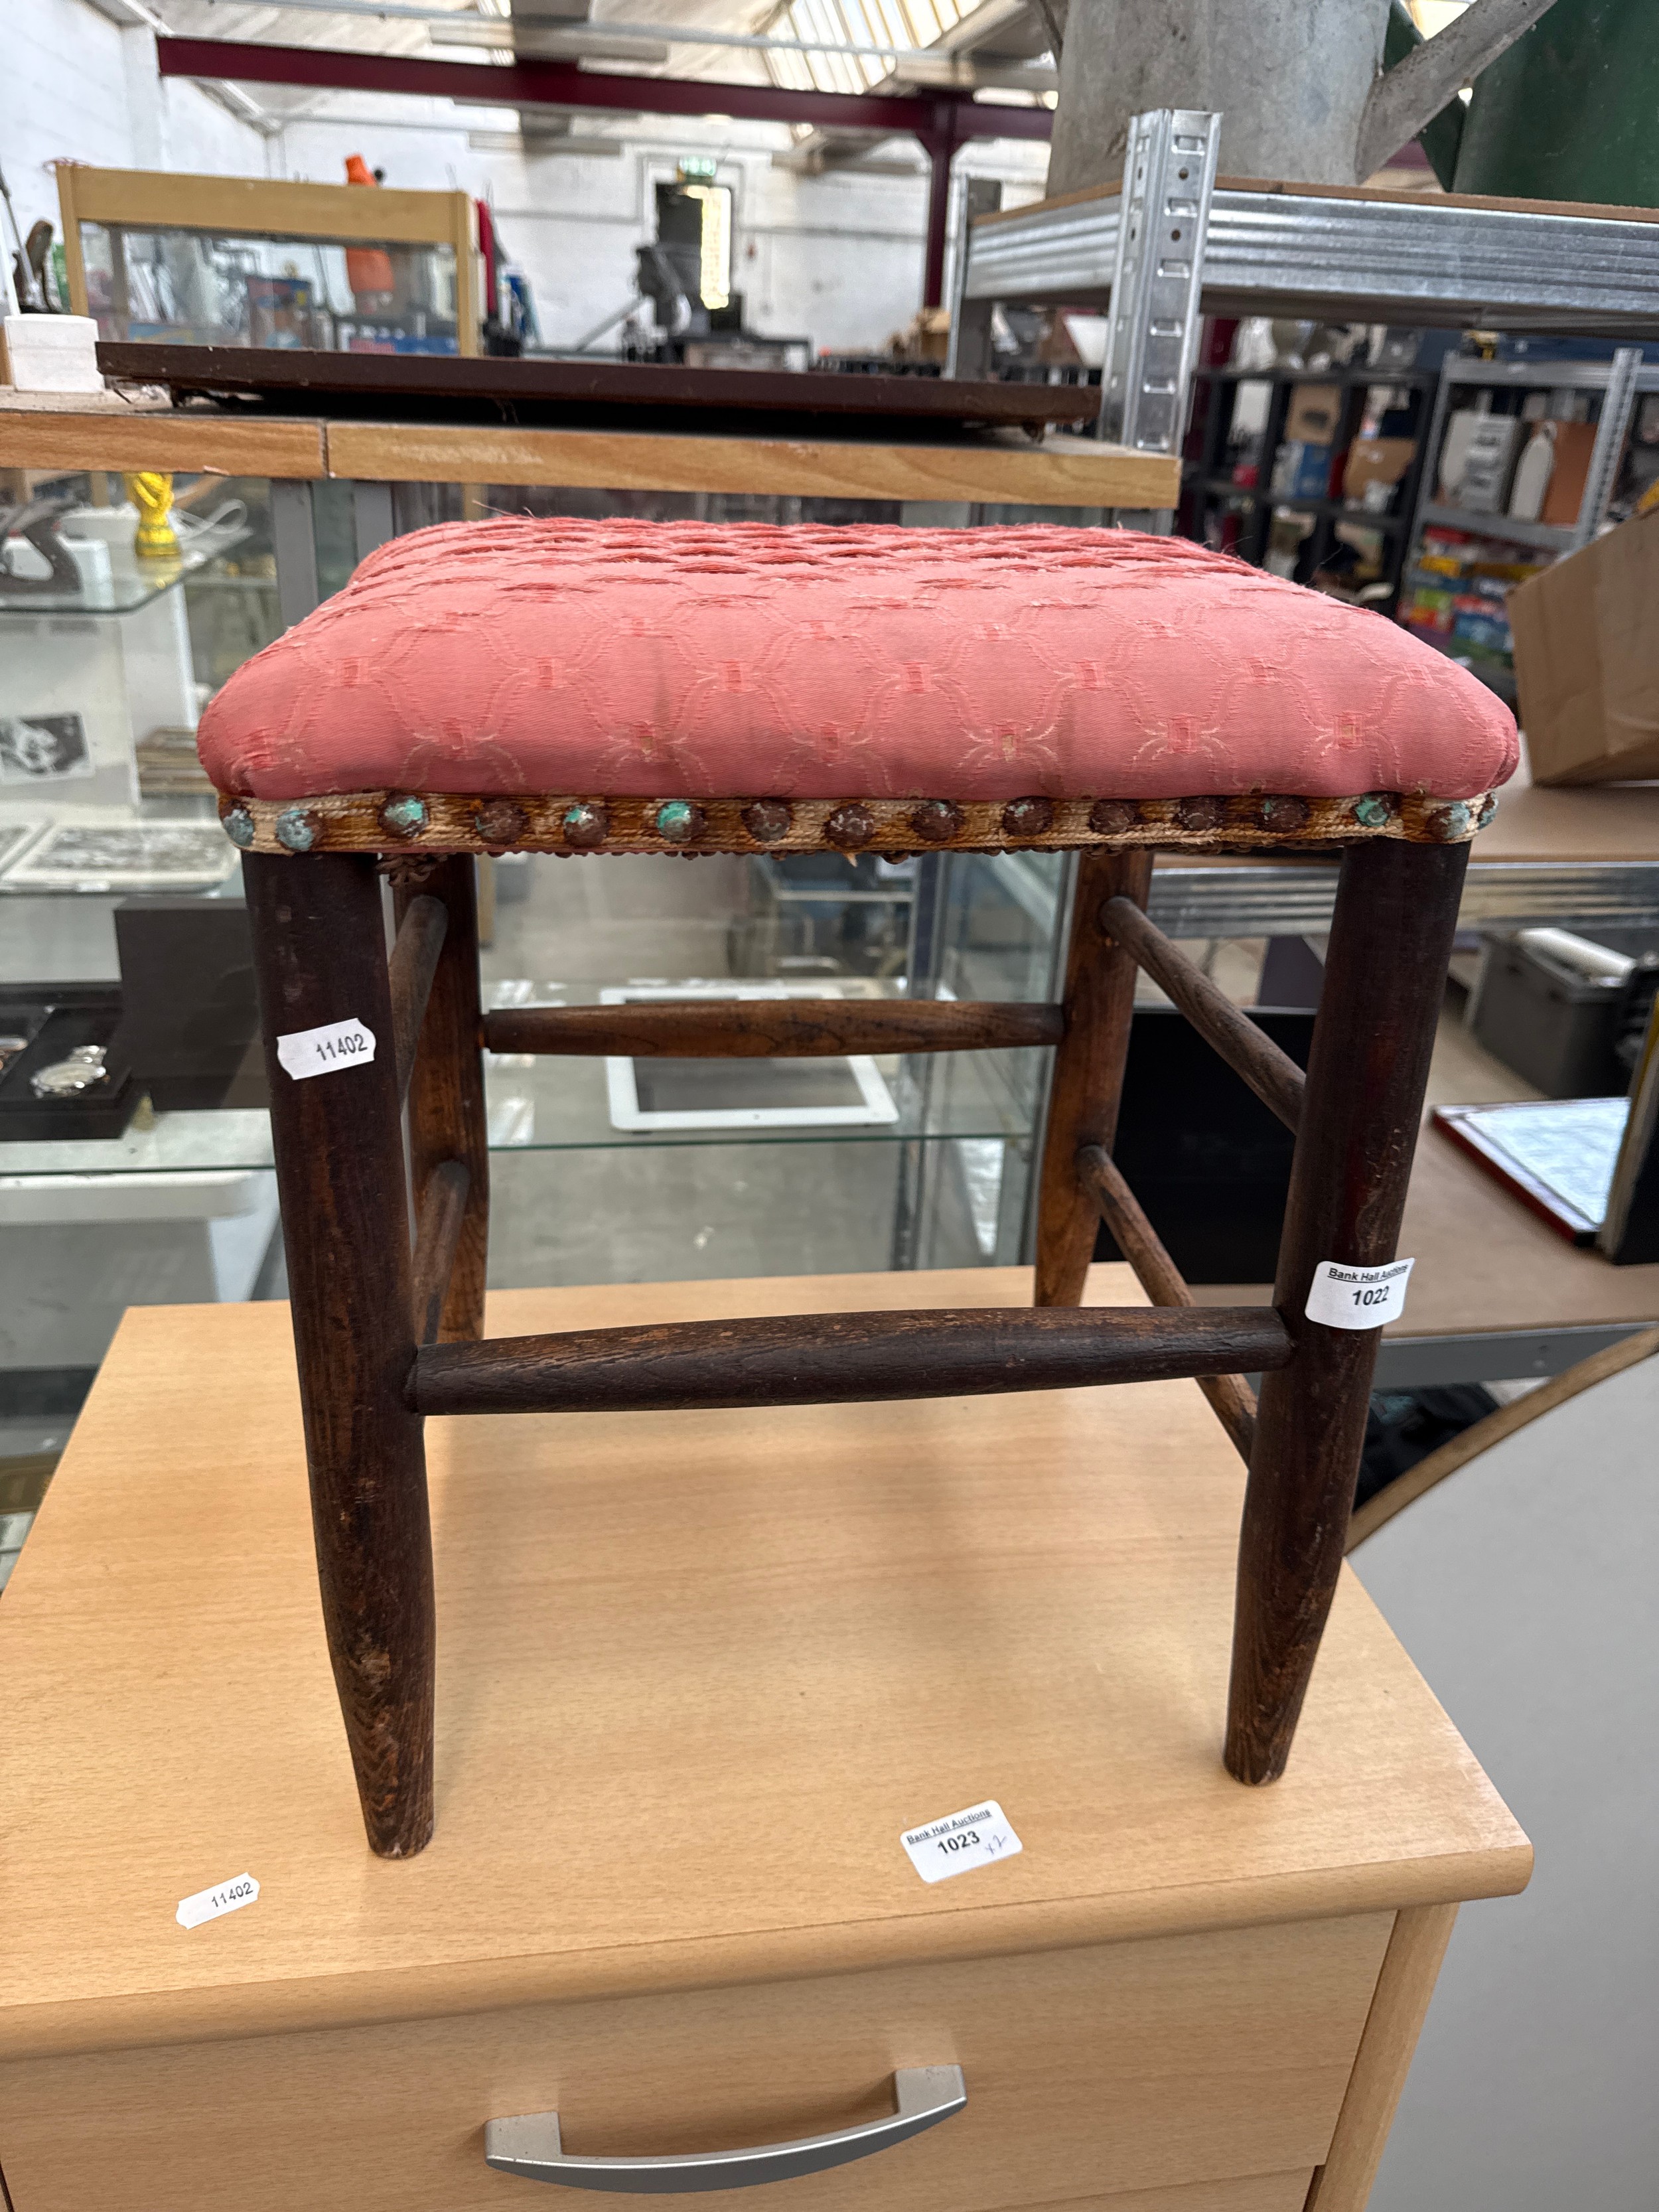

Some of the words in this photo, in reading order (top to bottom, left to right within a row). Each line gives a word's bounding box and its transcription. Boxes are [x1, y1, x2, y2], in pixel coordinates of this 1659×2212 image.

[316, 1033, 368, 1061] 11402
[1329, 1268, 1358, 1281] Bank
[1360, 1272, 1380, 1281] Hall
[1352, 1285, 1390, 1305] 1022
[906, 1830, 930, 1844] Bank
[932, 1822, 950, 1835] Hall
[952, 1808, 991, 1828] Auctions
[938, 1830, 980, 1854] 1023
[211, 1881, 253, 1907] 11402
